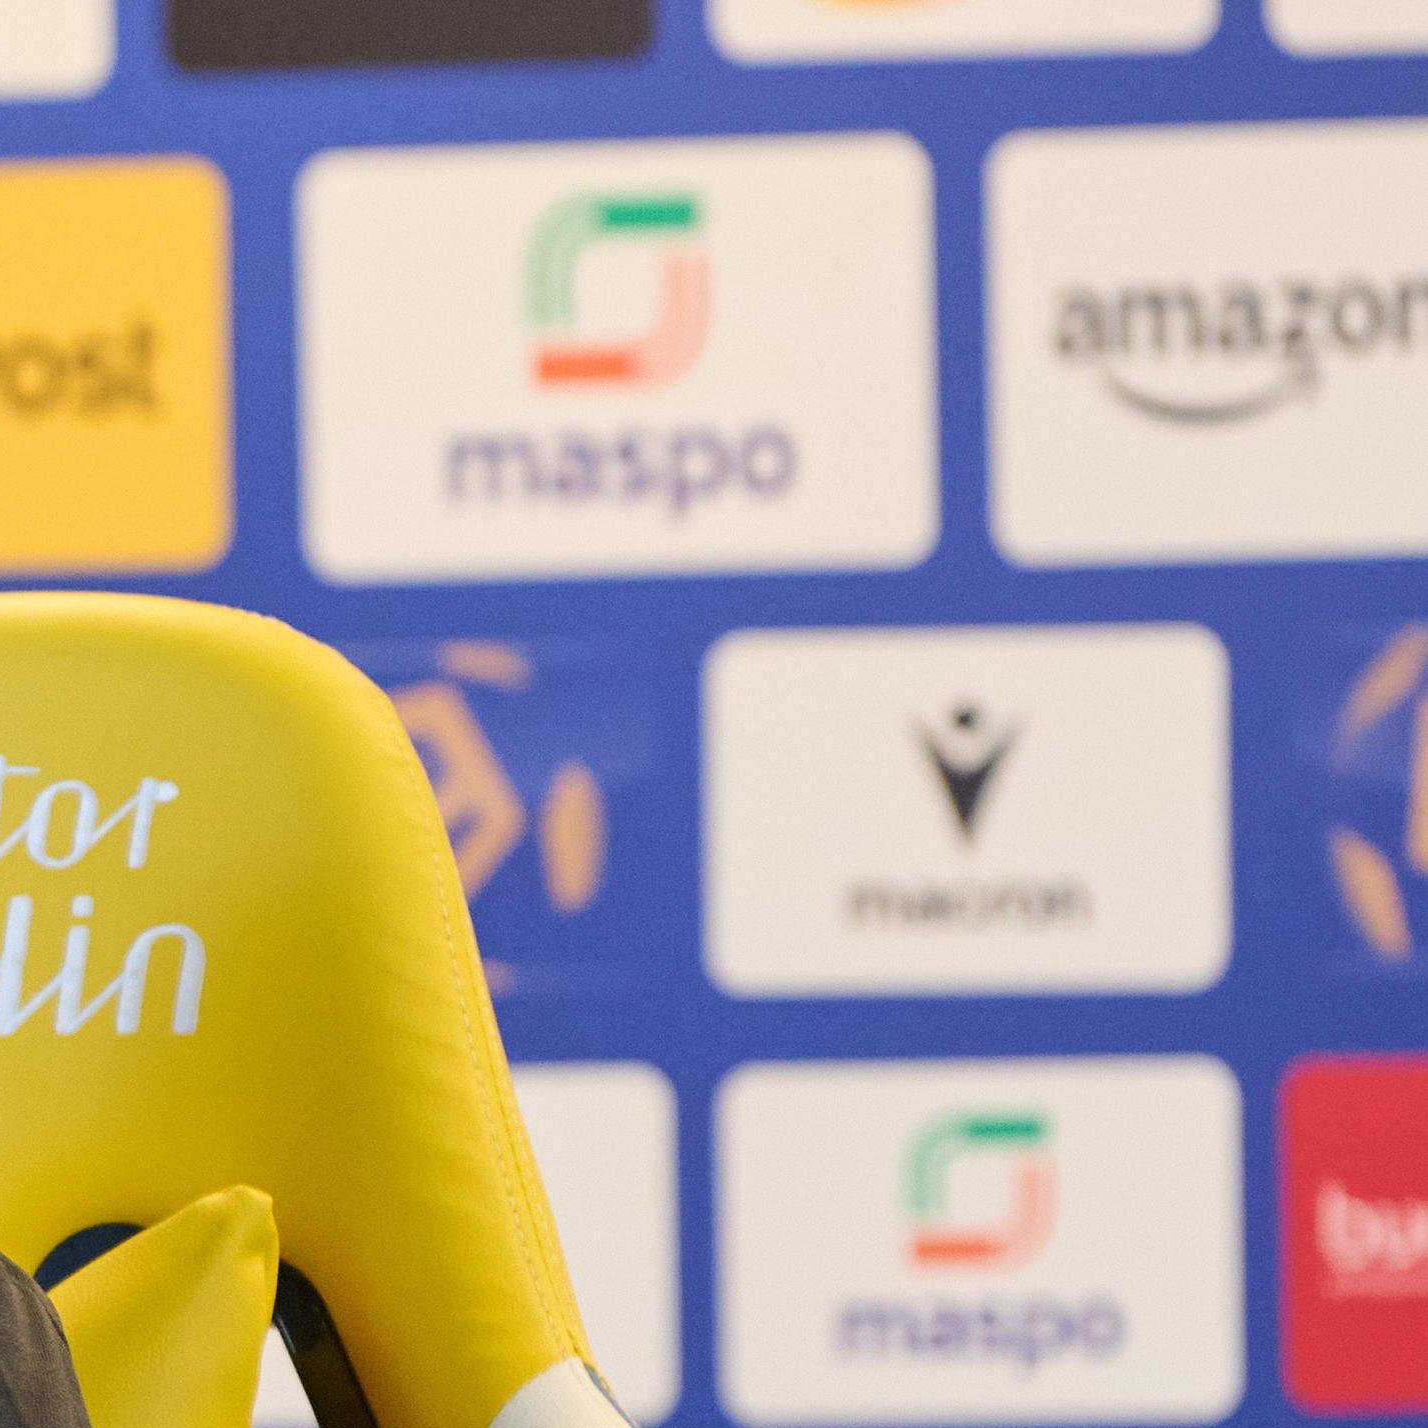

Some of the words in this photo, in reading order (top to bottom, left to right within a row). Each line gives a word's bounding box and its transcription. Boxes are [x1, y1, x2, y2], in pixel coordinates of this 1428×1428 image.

[444, 426, 798, 515] maspo
[843, 879, 1093, 929] macron
[837, 1298, 1126, 1378] maspo
